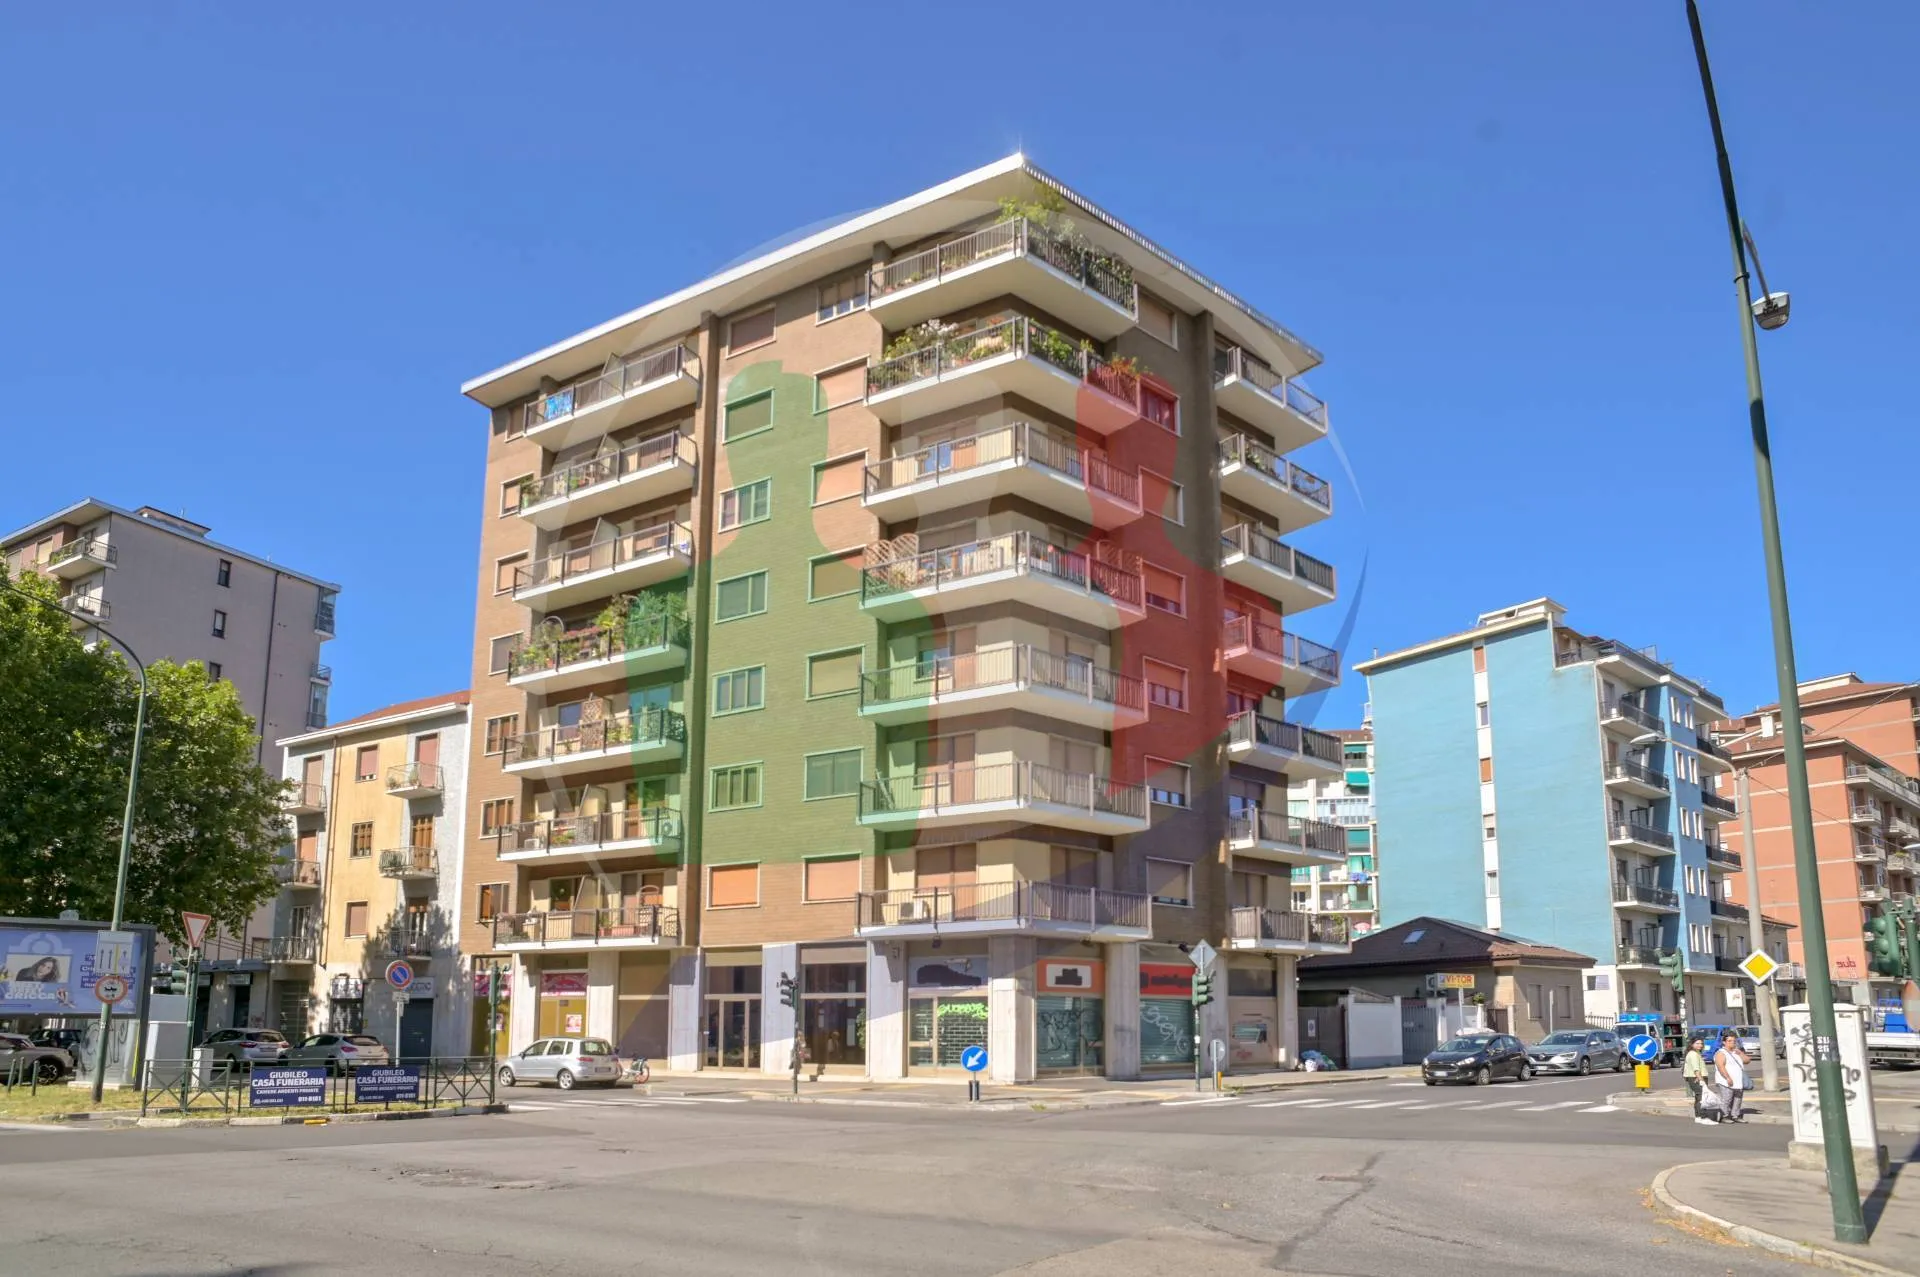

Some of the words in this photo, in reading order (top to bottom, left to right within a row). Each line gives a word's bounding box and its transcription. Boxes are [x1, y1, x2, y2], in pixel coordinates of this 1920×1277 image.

[269, 1071, 308, 1079] GIUBILEO
[356, 1076, 376, 1084] CASA
[377, 1075, 418, 1083] FUNERARIA
[252, 1078, 275, 1087] CASA
[276, 1077, 324, 1086] FUNERARIA
